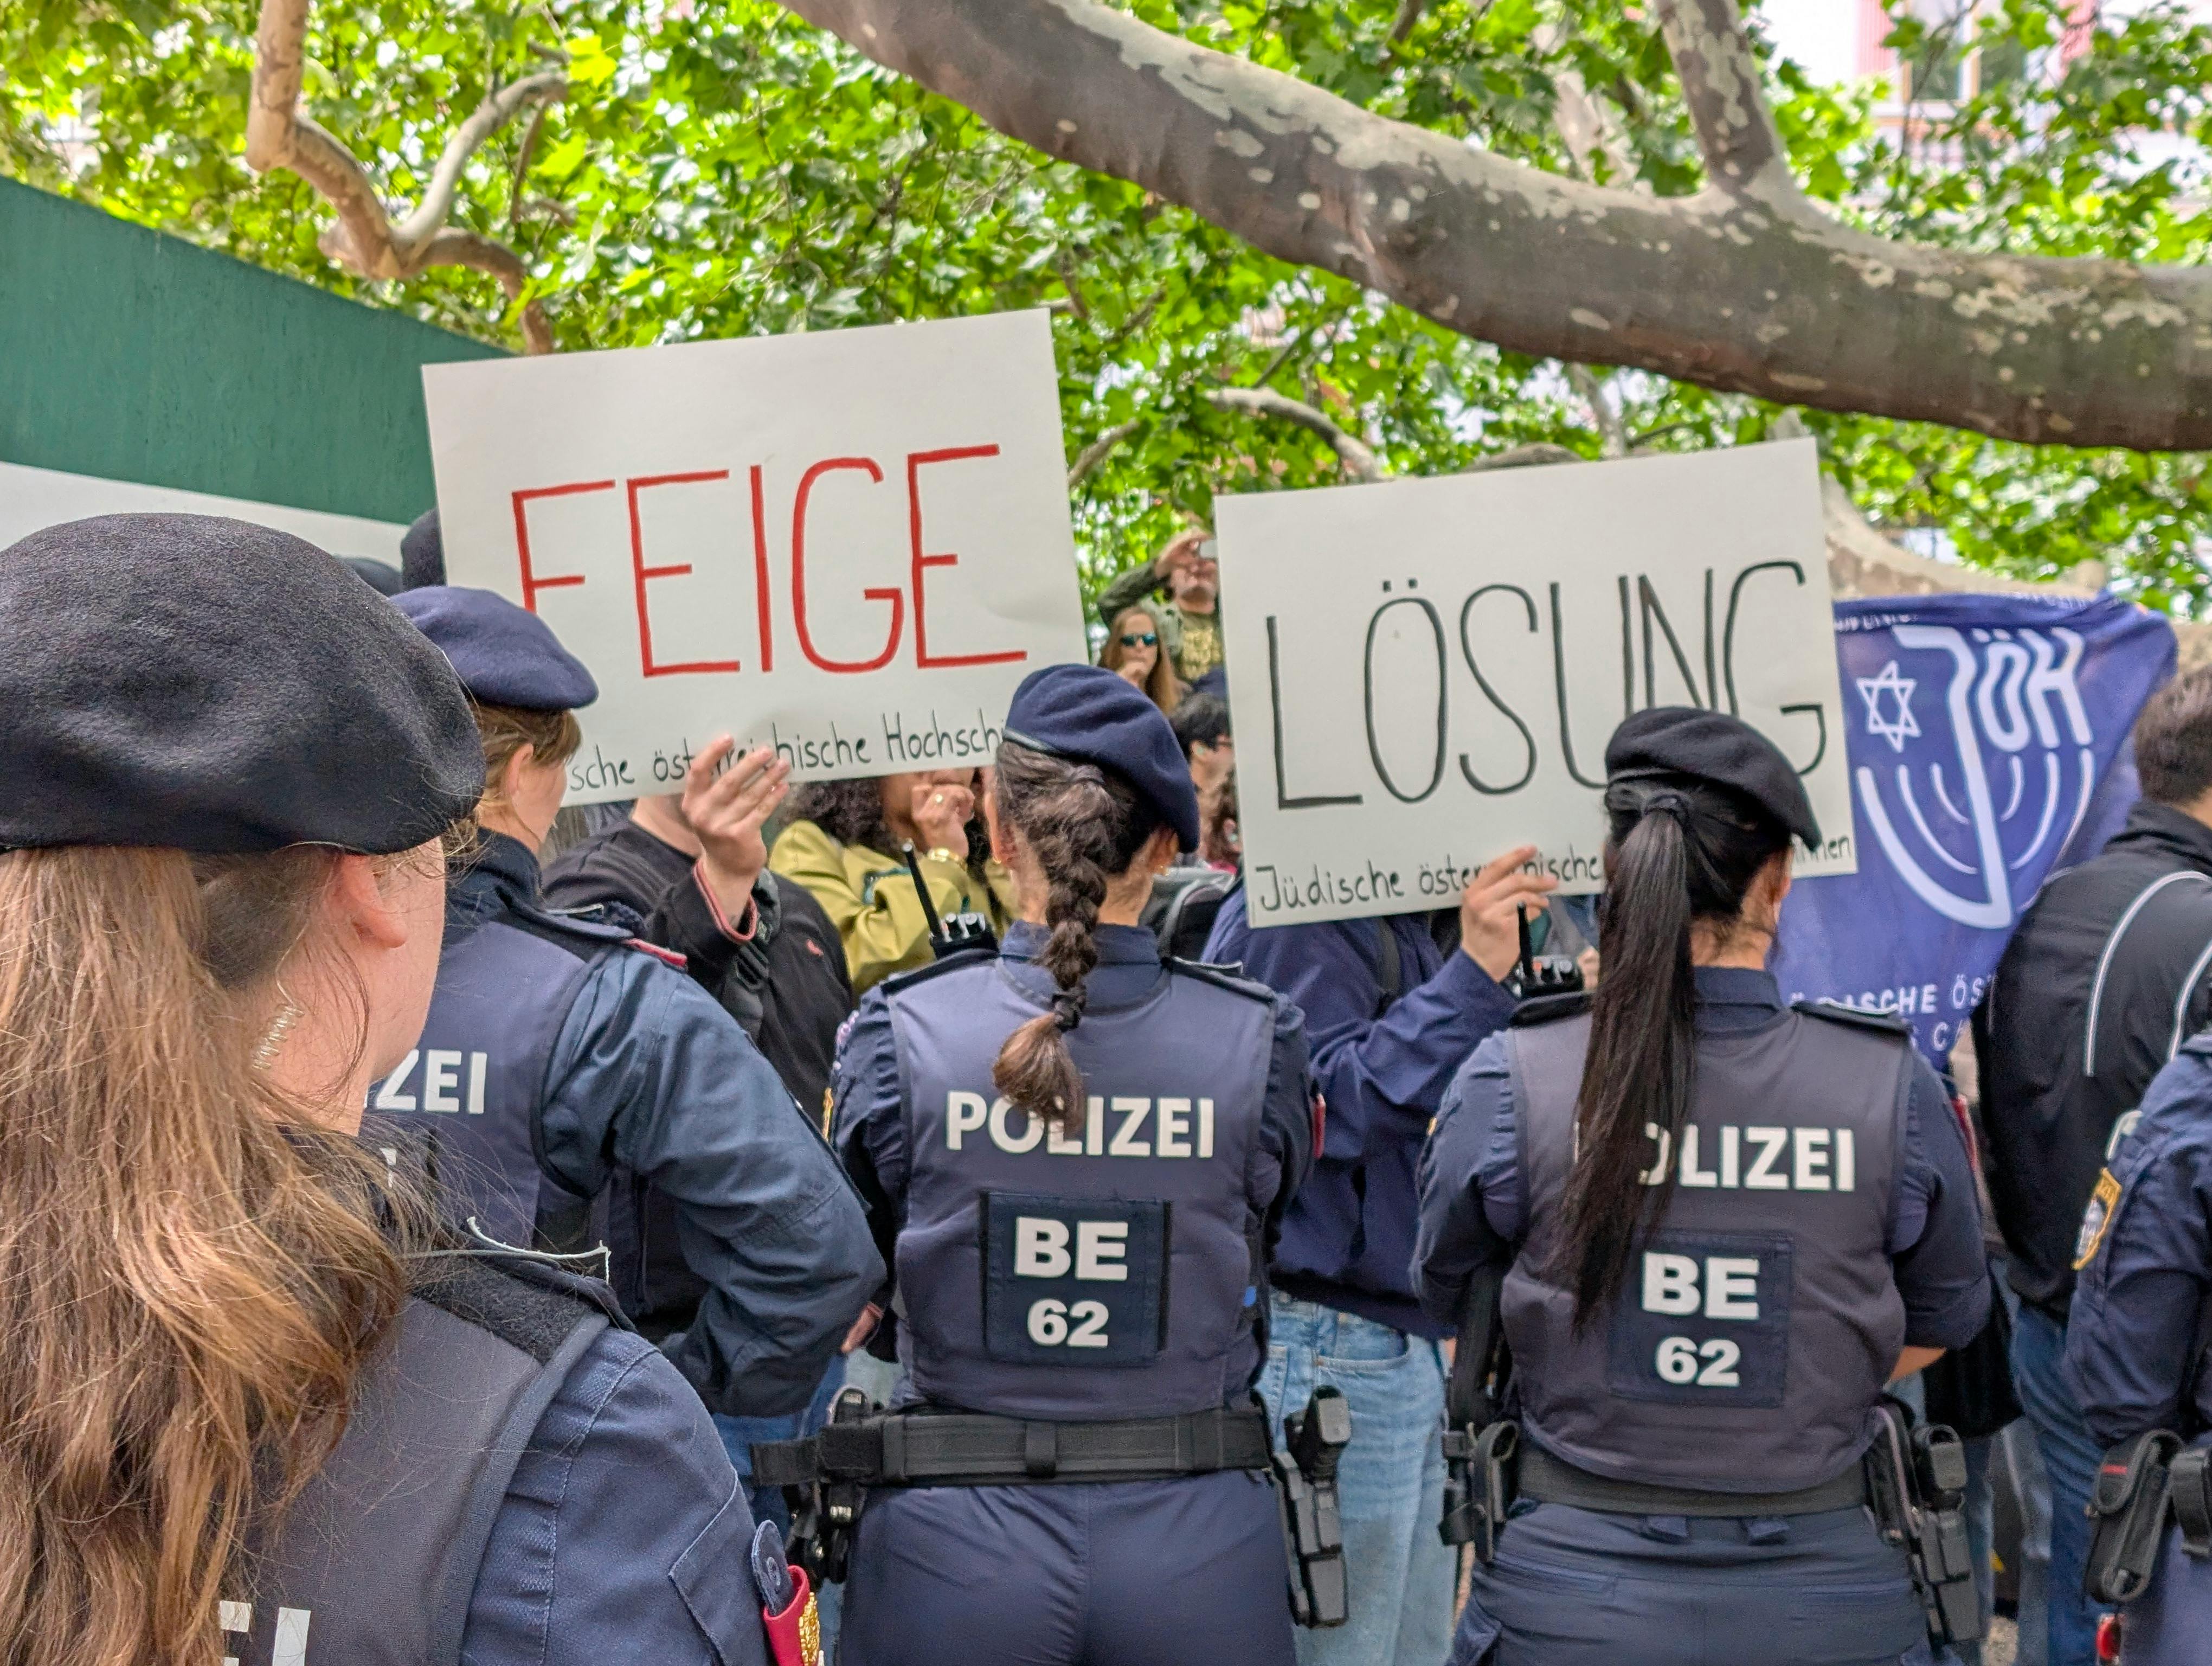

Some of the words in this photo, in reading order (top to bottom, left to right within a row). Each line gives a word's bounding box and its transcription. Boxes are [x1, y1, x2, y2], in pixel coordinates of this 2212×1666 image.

[511, 443, 1028, 678] FEIGE
[1266, 560, 1828, 810] LÖSUNG
[569, 744, 635, 791] sche
[1255, 858, 1405, 912] Jüdische
[364, 1049, 487, 1114] ZEI
[946, 1090, 1214, 1158] POLIZEI
[1014, 1216, 1129, 1281] BE
[1641, 1251, 1760, 1320] BE
[1027, 1299, 1109, 1348] 62
[1655, 1336, 1740, 1387] 62
